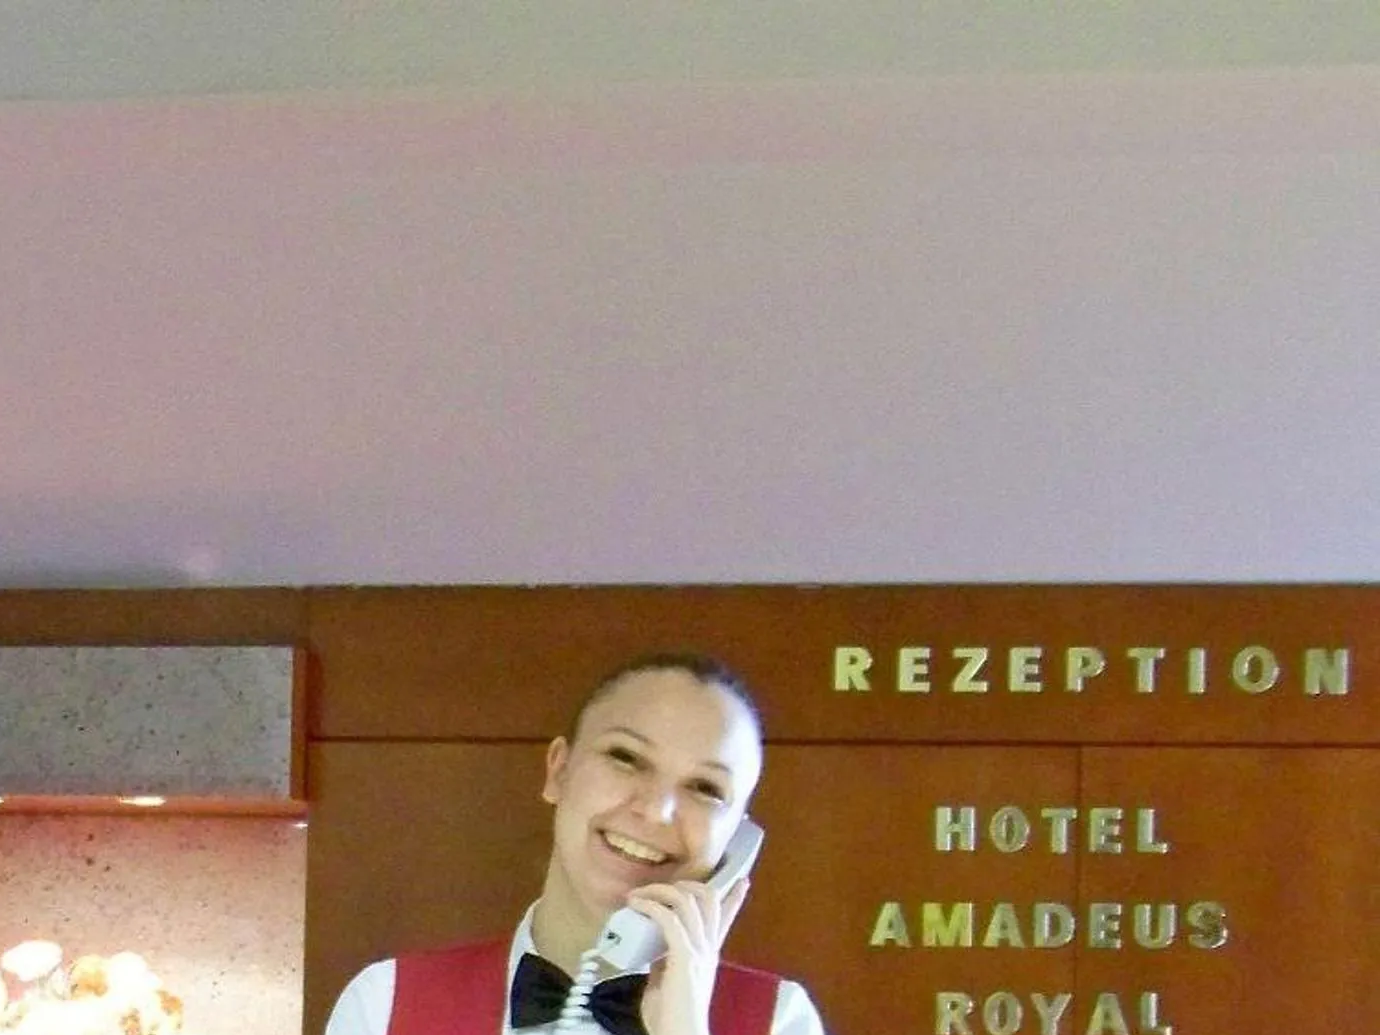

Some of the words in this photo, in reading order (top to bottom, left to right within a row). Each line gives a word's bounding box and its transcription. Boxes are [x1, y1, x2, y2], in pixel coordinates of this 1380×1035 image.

[833, 646, 1350, 695] REZEPTION
[934, 806, 1170, 854] HOTEL
[869, 901, 1230, 949] AMADEUS
